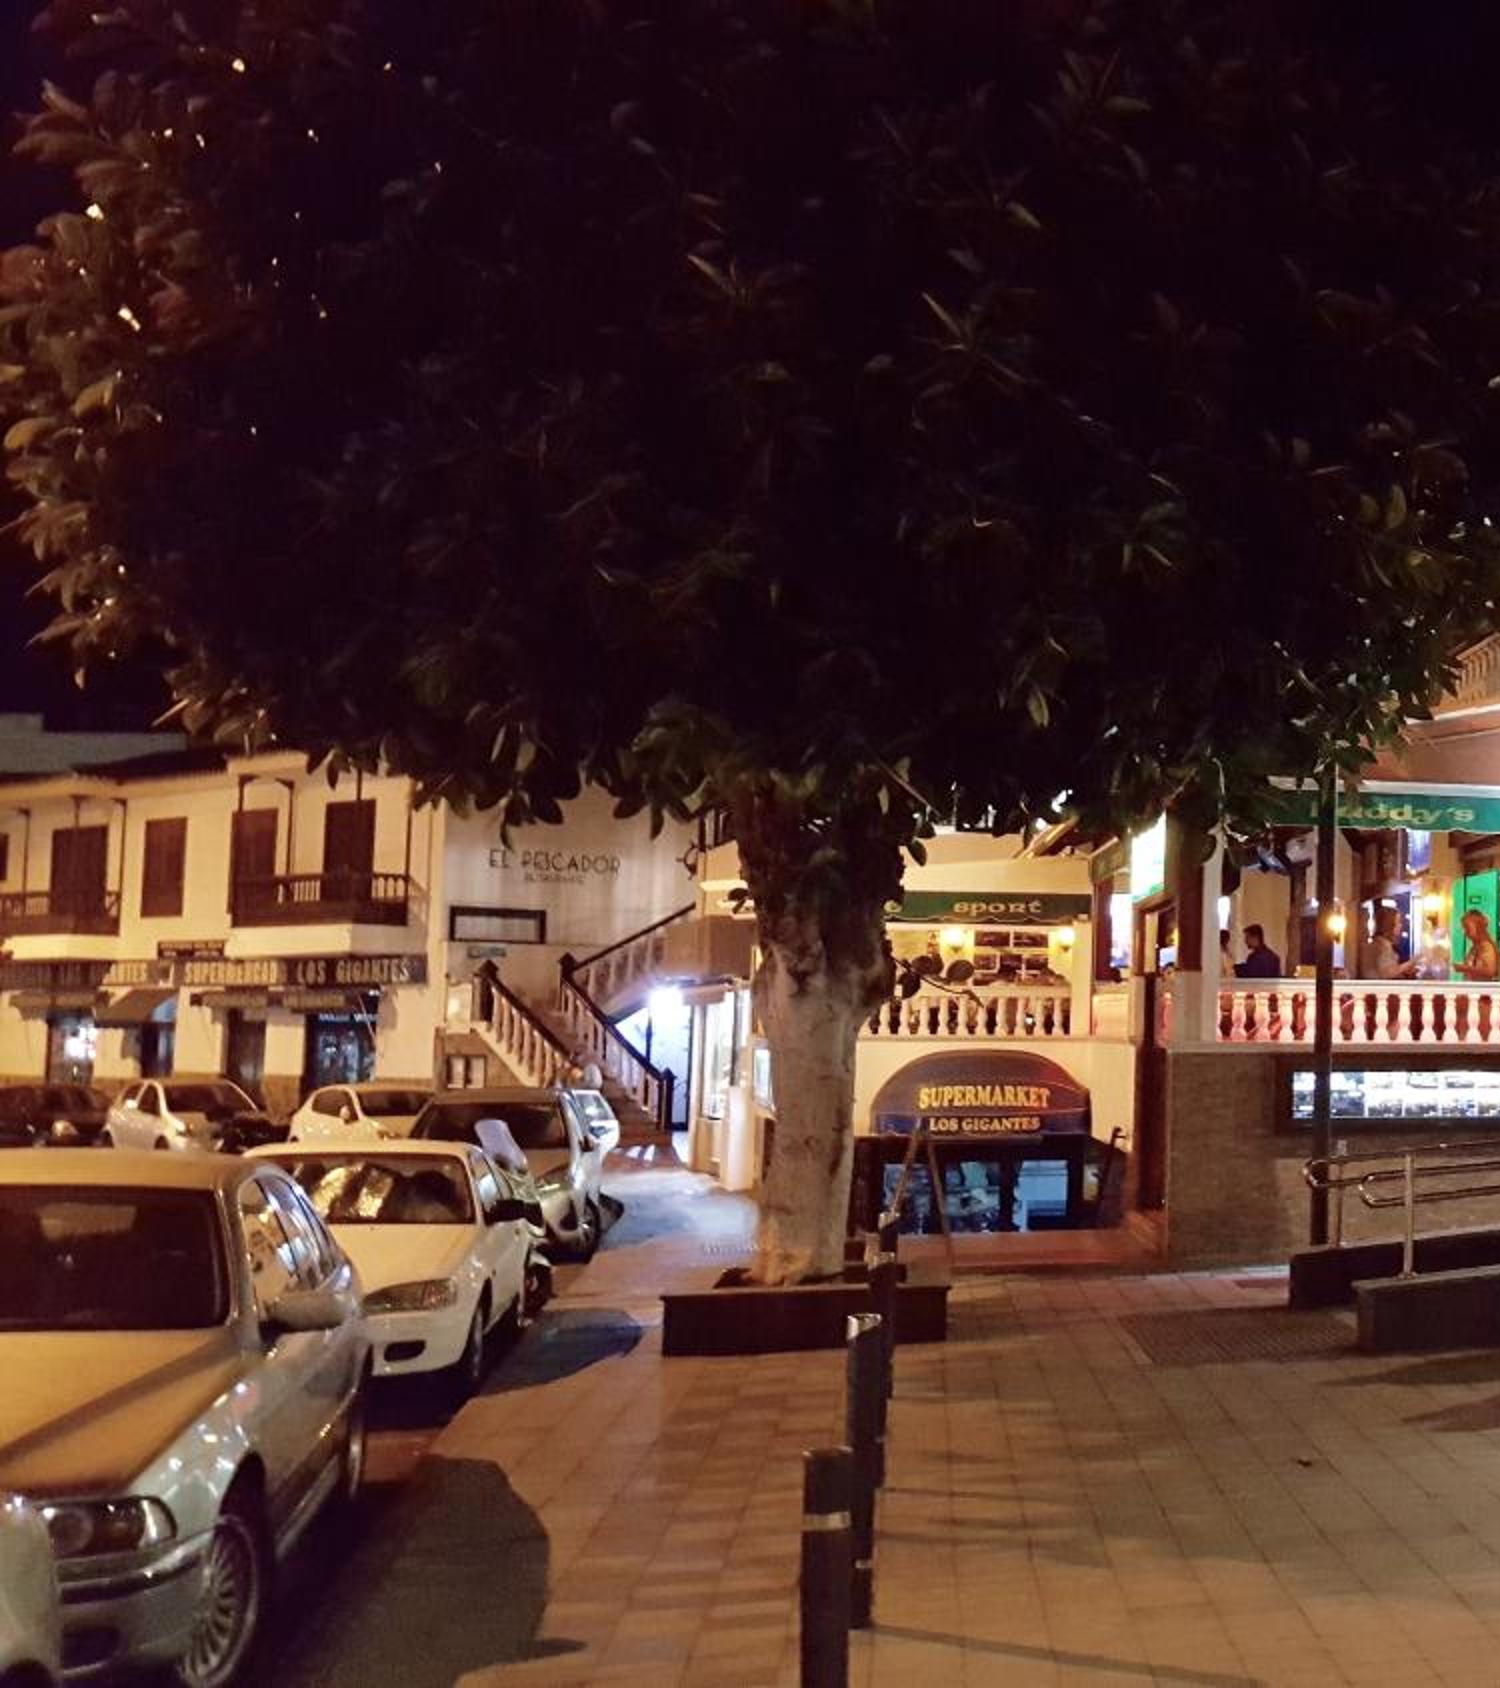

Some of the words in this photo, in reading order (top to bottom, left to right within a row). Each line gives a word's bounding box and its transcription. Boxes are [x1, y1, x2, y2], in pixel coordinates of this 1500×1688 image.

[489, 848, 509, 868] EL
[520, 849, 622, 875] PESCADOR
[296, 961, 326, 984] LOS
[335, 957, 410, 984] GIGANTES
[918, 1084, 1051, 1109] SUPERMARKET
[929, 1117, 959, 1131] LOS
[962, 1116, 1041, 1131] GIGANTES
